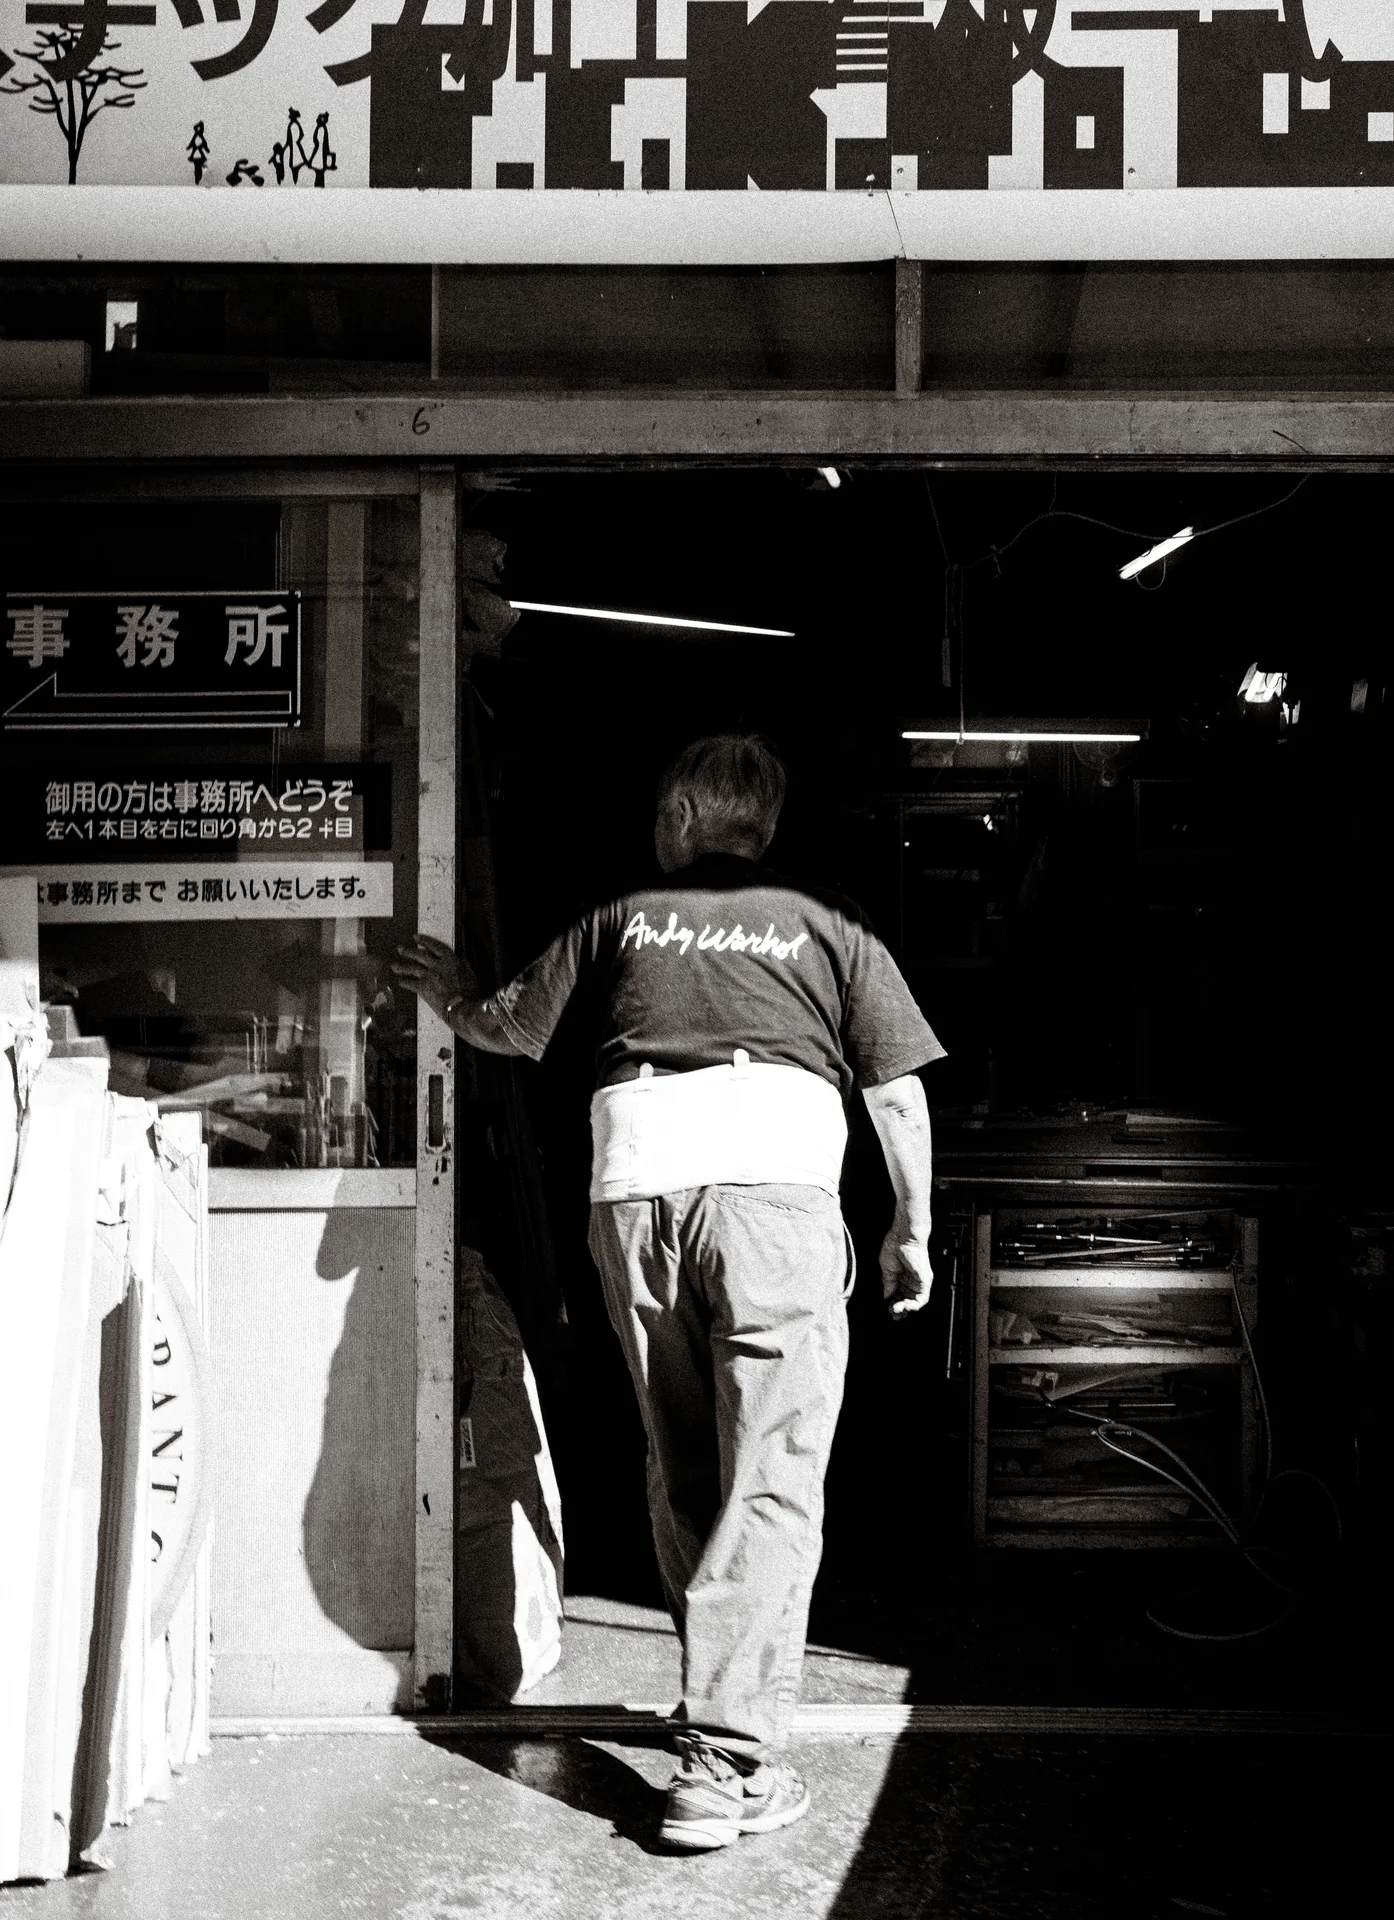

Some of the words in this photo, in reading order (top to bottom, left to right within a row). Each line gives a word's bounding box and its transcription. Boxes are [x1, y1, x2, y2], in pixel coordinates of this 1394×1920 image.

[411, 407, 430, 436] 6
[6, 605, 290, 668] 事務所
[45, 779, 354, 815] 御用の方は事務所へどうぞ
[621, 912, 694, 955] Andy
[697, 922, 808, 960] Warhol
